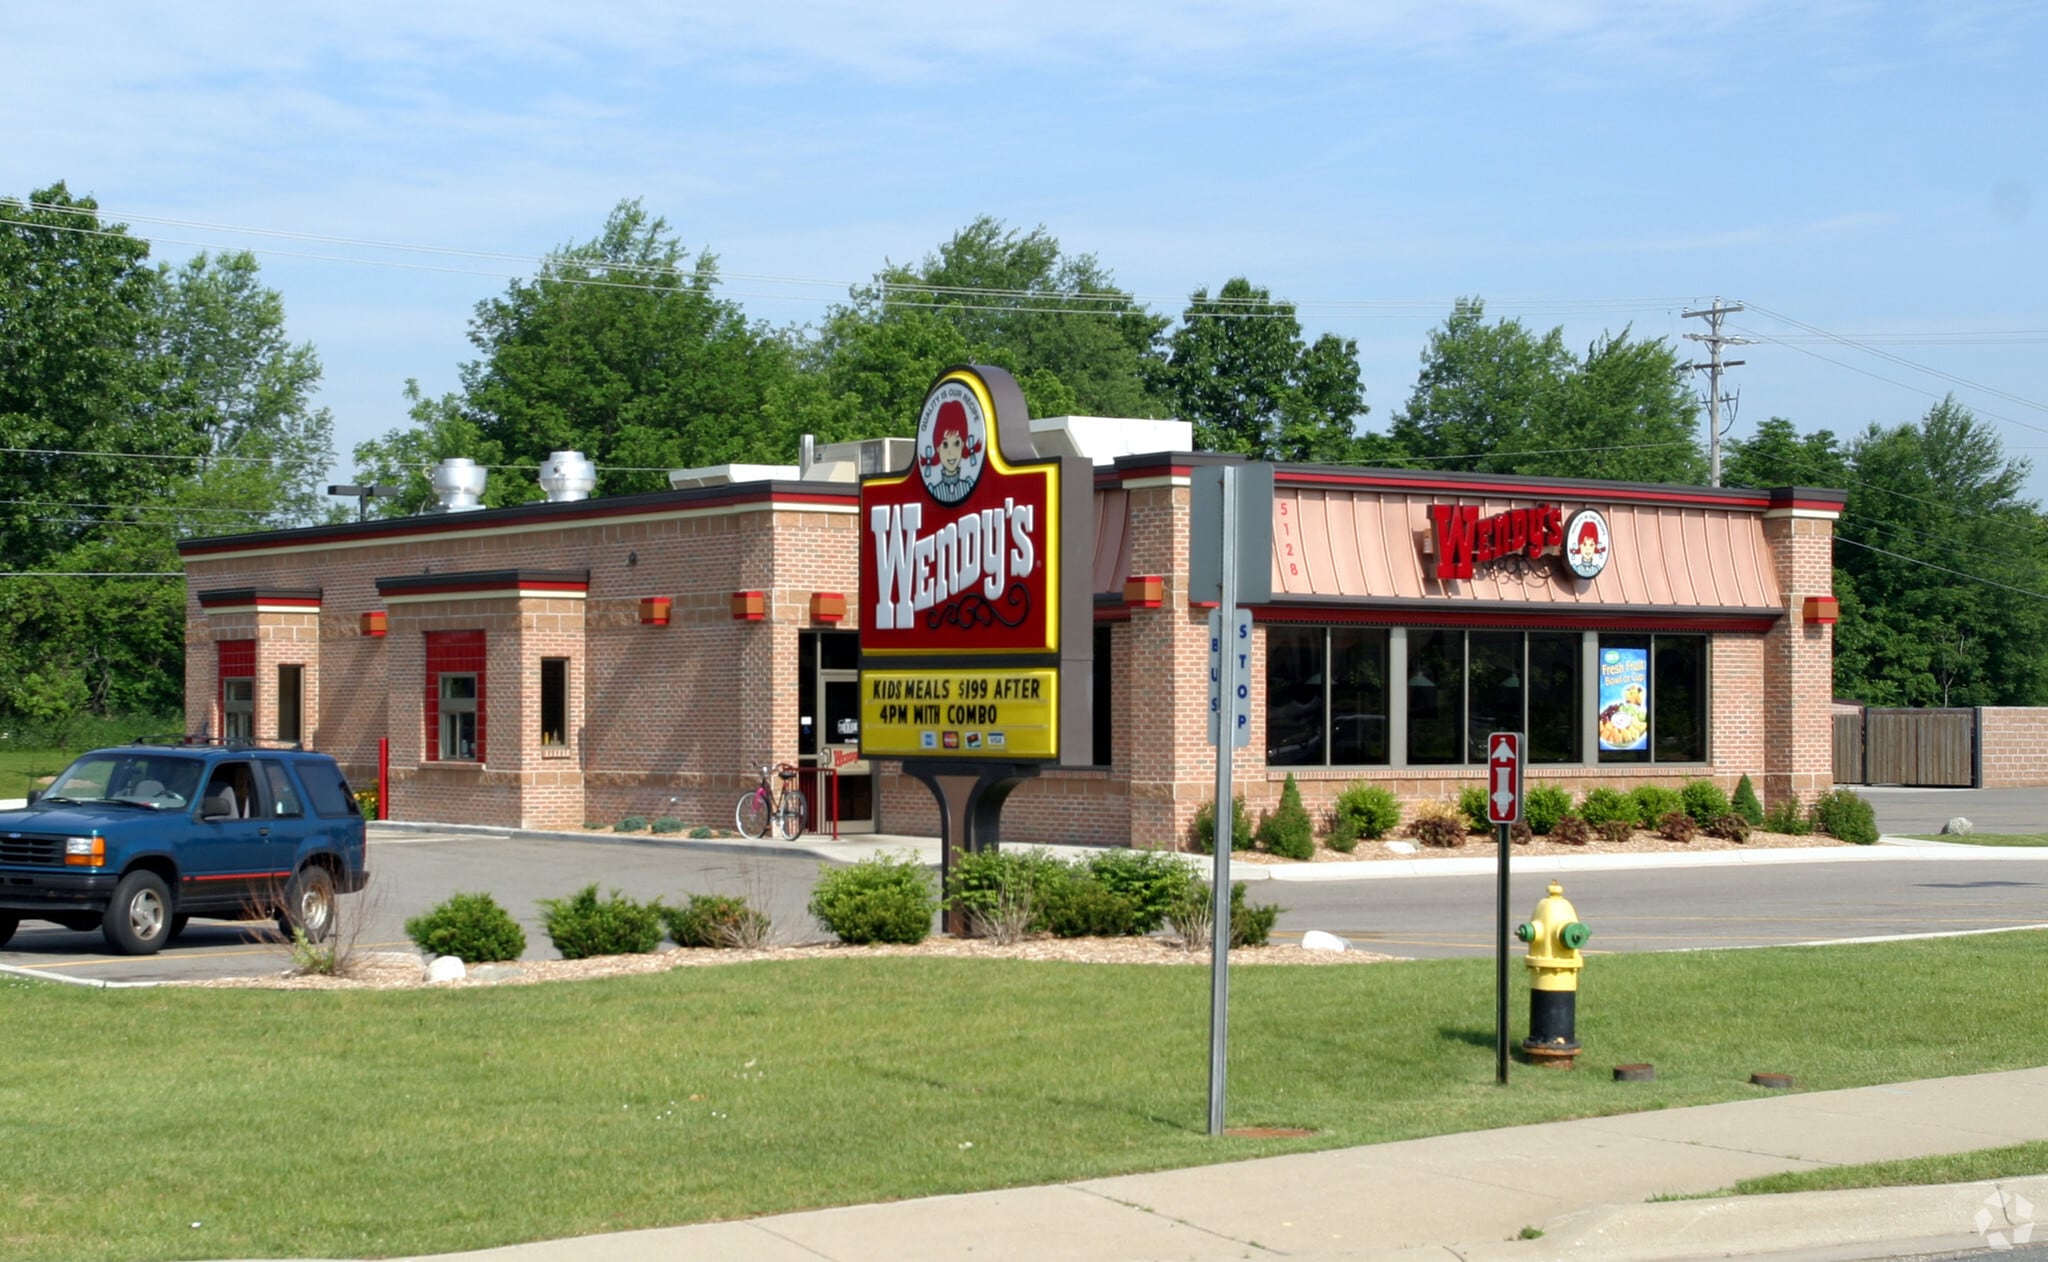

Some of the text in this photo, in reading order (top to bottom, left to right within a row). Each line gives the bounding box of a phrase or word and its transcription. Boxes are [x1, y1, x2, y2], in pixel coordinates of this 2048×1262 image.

[871, 497, 1034, 629] Wendy's
[1433, 502, 1563, 579] Wendy's
[873, 679, 901, 699] KIDS
[904, 679, 950, 699] MEALS
[993, 678, 1040, 699] AFTER
[879, 704, 997, 724] 4PM WITH COMBO
[1237, 623, 1248, 728] STOP
